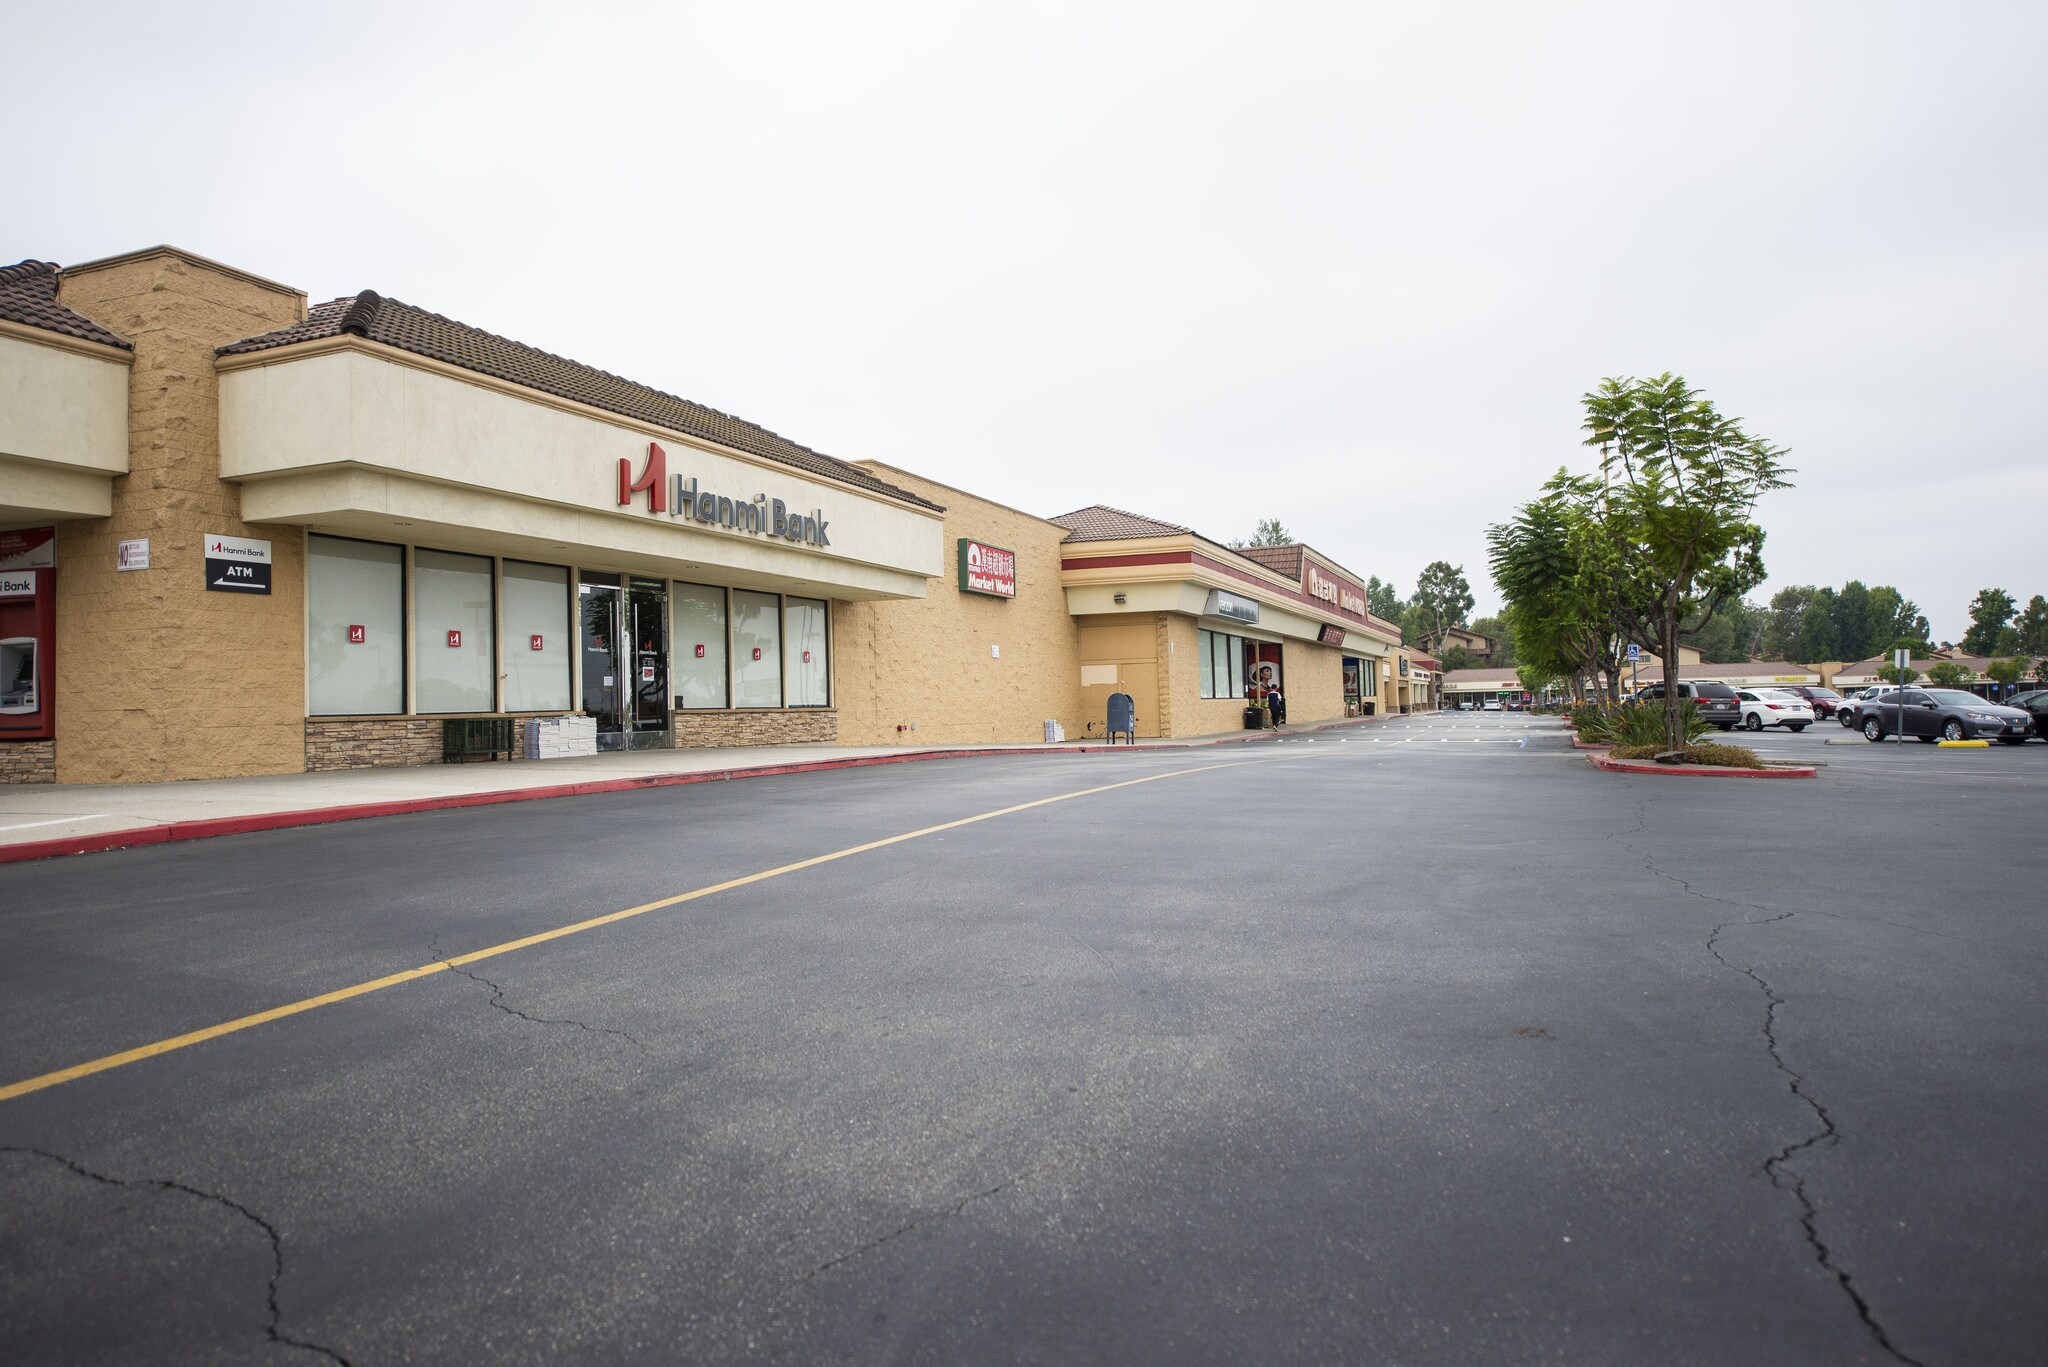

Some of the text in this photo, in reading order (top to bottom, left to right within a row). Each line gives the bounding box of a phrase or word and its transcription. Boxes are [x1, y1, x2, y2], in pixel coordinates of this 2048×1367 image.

[670, 473, 830, 546] Hanmi Bank
[120, 544, 129, 567] NO
[223, 546, 265, 557] Hanmi Bank
[226, 566, 252, 577] ATM
[4, 580, 31, 591] Bank
[968, 573, 1015, 595] Market World
